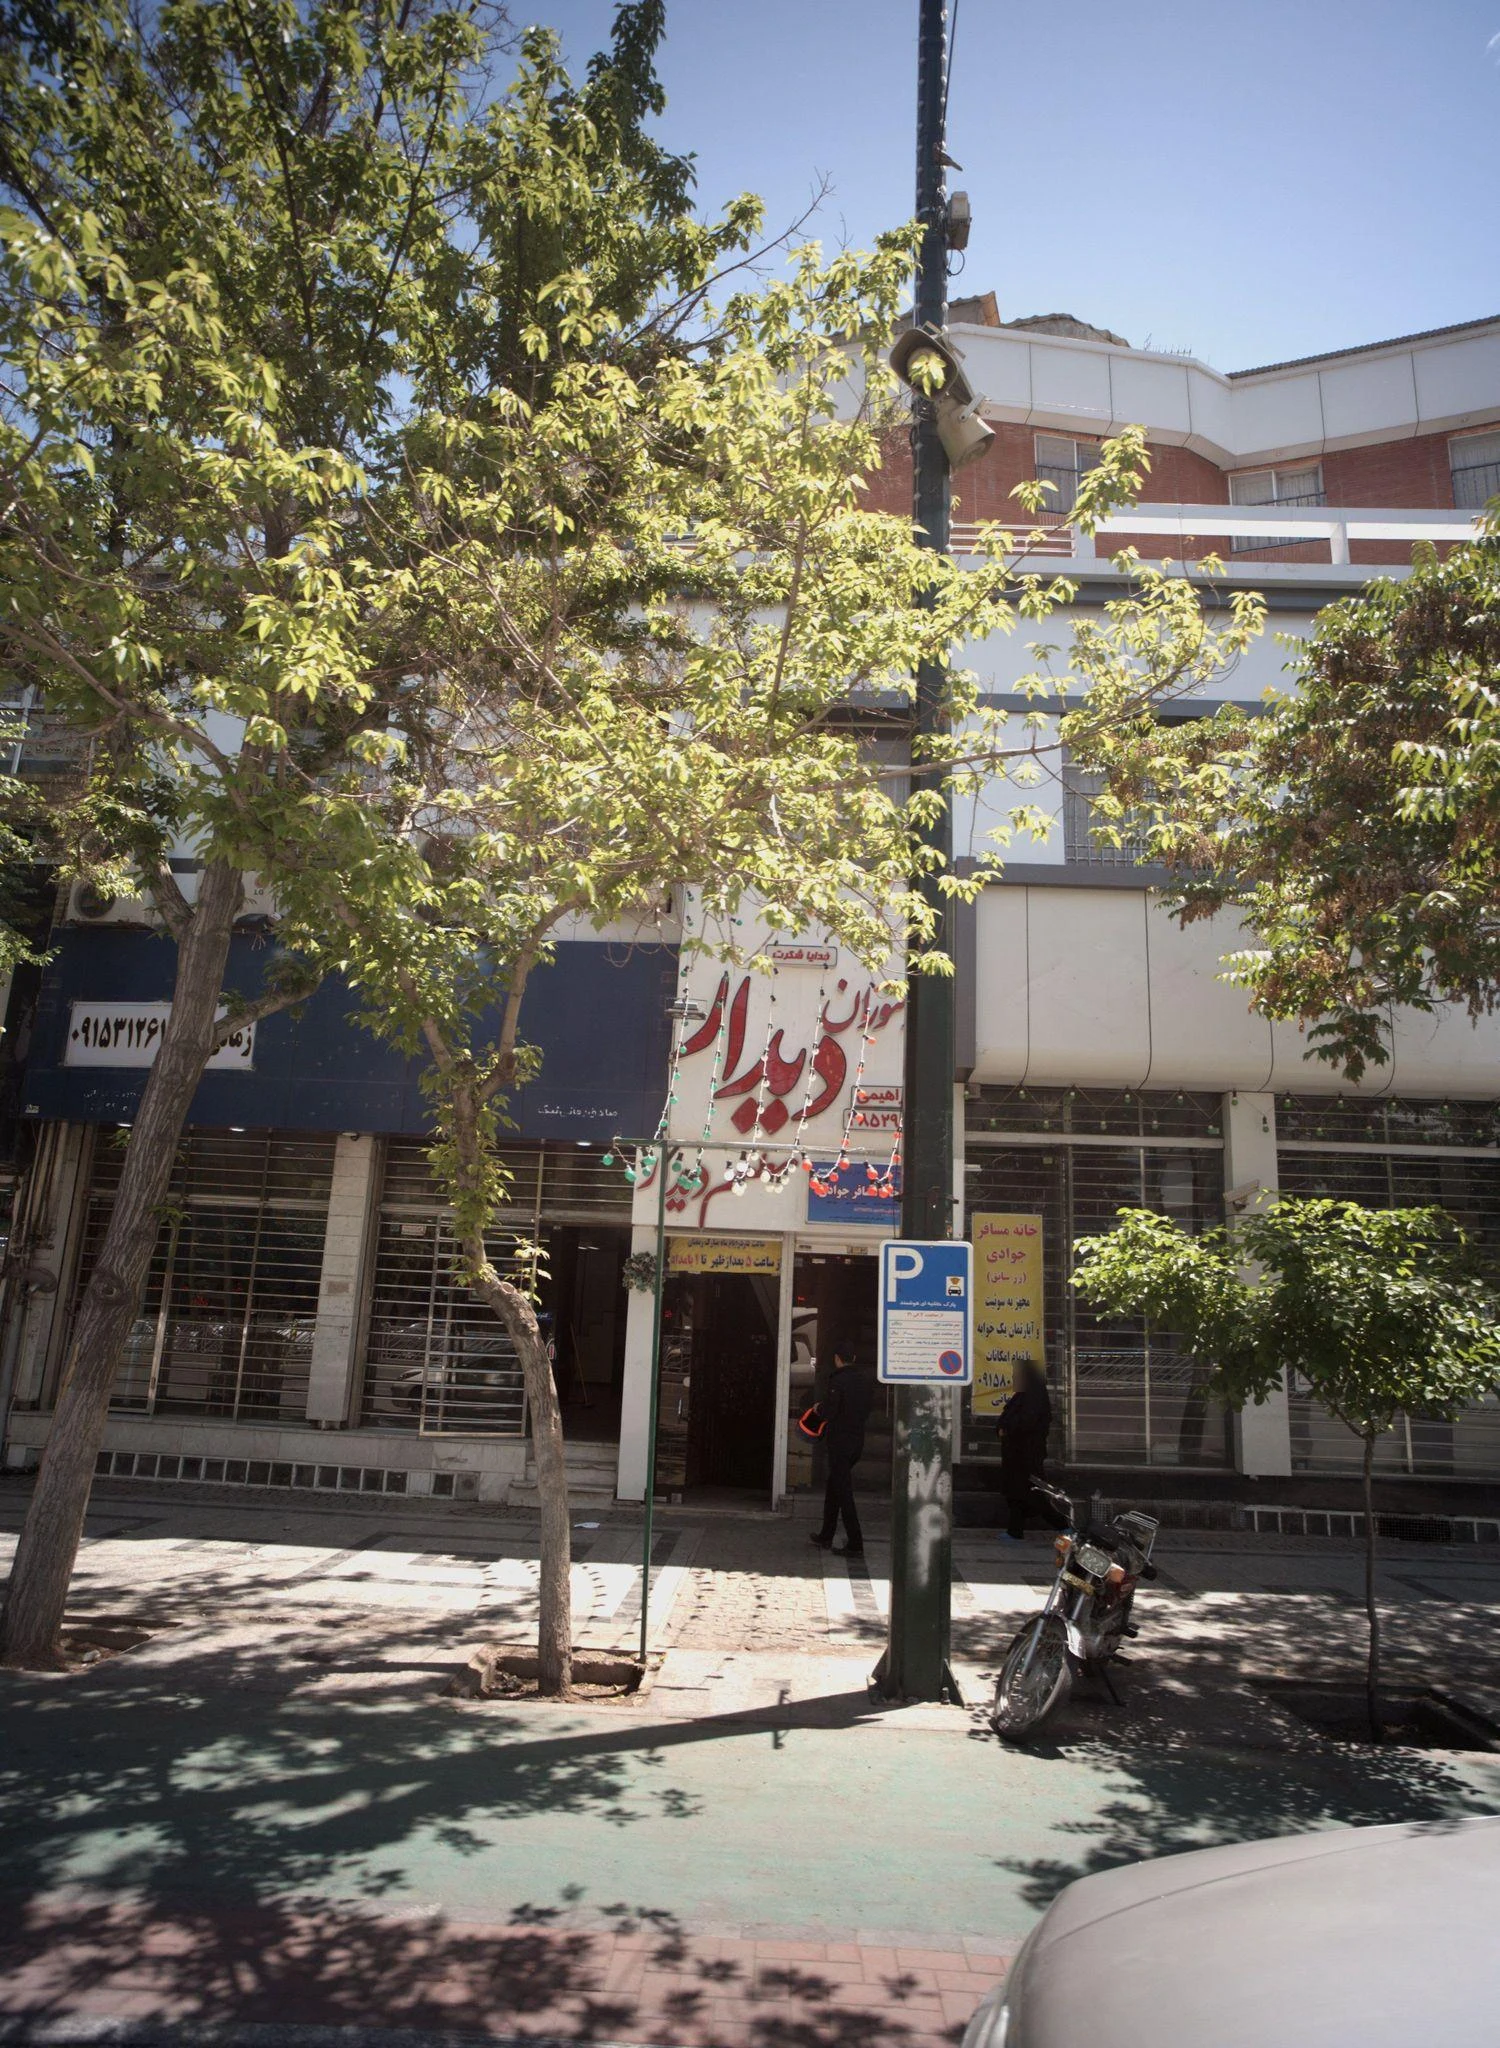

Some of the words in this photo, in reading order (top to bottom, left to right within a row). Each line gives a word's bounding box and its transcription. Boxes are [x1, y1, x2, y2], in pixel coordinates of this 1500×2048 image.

[772, 949, 804, 960] شکرت
[806, 950, 831, 962] خدایا
[71, 1016, 167, 1049] ۰۹۱۵۳۱۲۶۱
[673, 971, 847, 1135] دیدار
[977, 1222, 1010, 1239] مسافر
[1013, 1223, 1038, 1237] خانه
[701, 1254, 708, 1265] تا
[753, 1256, 775, 1268] ساعت
[986, 1247, 1027, 1264] جوادی
[887, 1247, 924, 1303] P
[978, 1371, 1012, 1388] ۰۹۱۵۸۰
